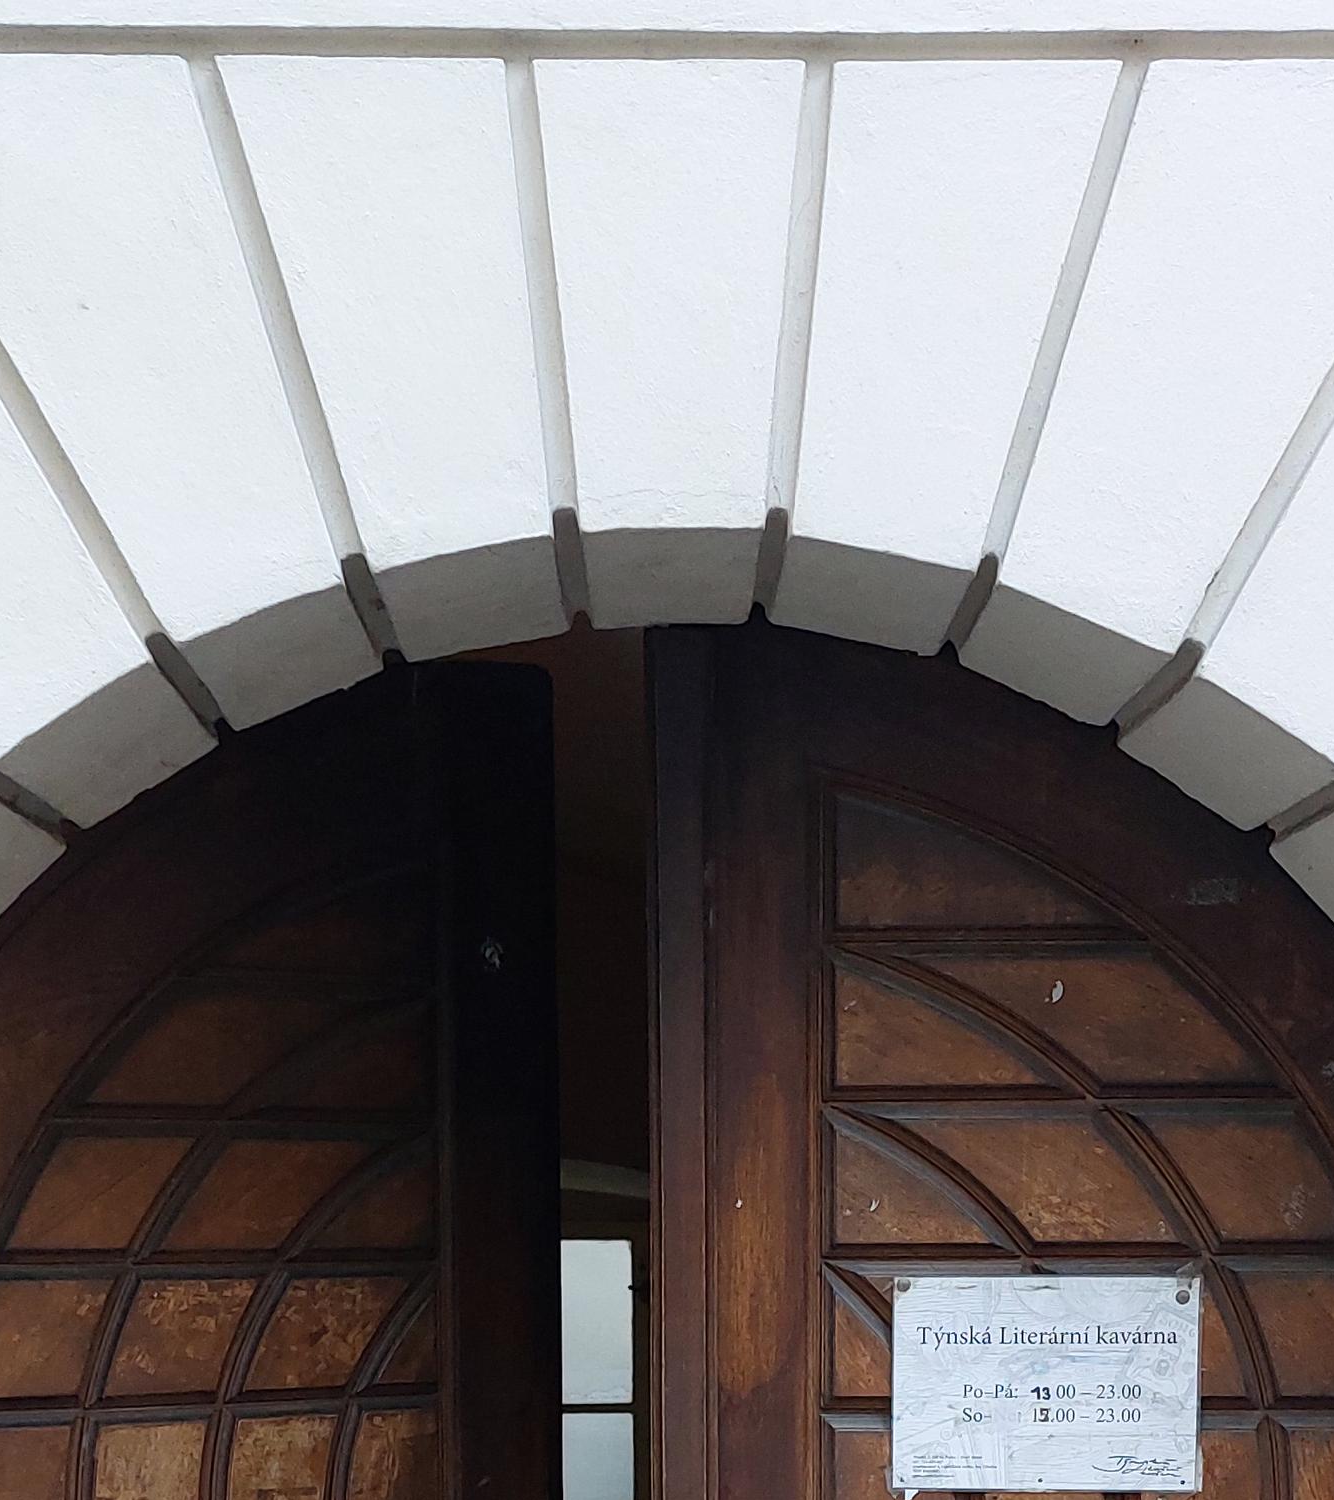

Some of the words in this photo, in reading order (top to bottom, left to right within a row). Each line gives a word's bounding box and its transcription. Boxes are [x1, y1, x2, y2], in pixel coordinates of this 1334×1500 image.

[916, 1325, 993, 1352] Týnská
[998, 1325, 1091, 1345] Literární
[1095, 1325, 1179, 1345] kavárna
[1095, 1383, 1142, 1400] 23.00
[1095, 1407, 1142, 1423] 23.00
